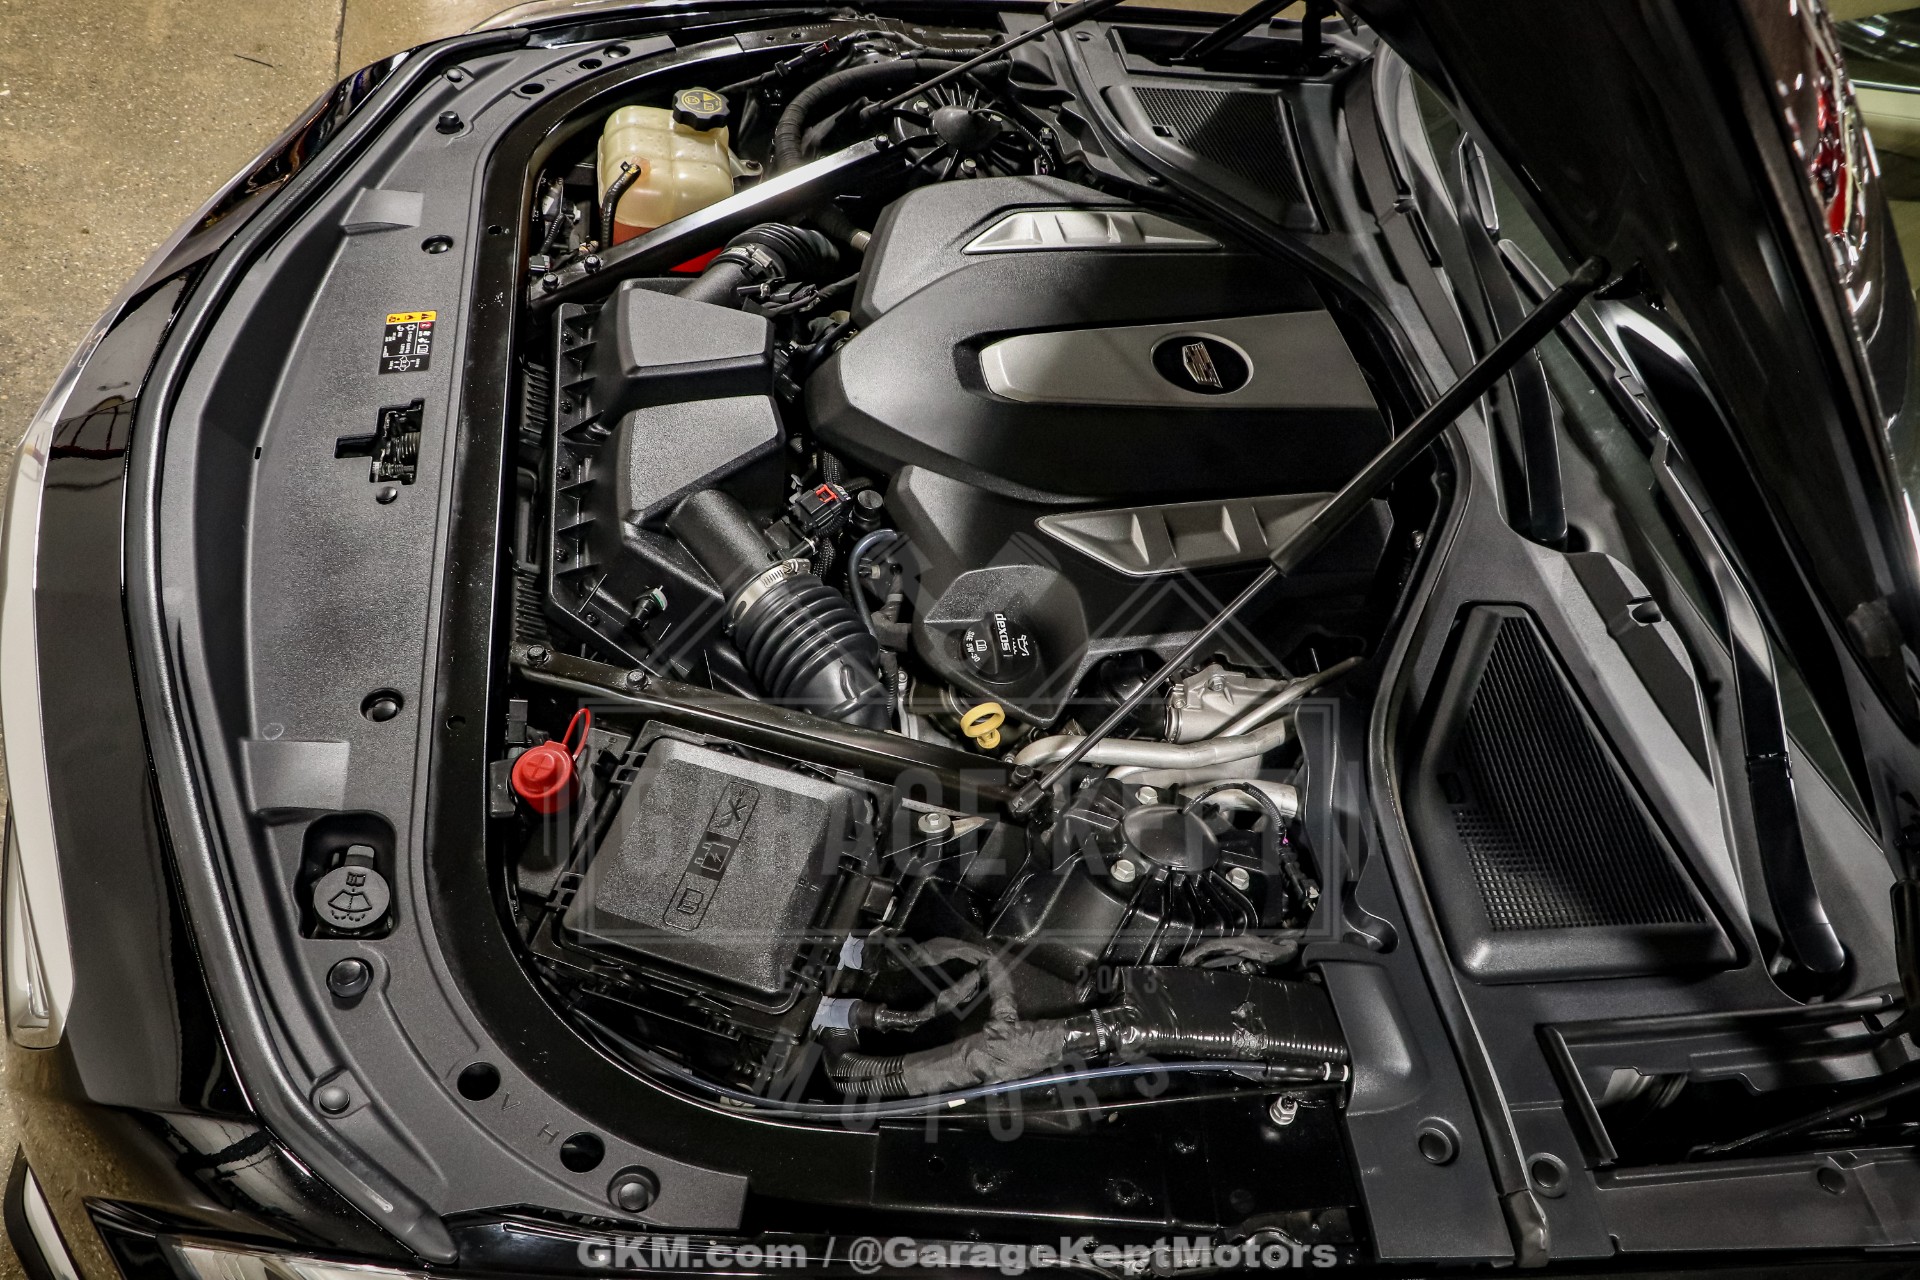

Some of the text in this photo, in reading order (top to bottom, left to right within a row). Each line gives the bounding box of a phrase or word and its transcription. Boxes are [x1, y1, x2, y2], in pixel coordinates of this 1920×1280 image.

[965, 630, 981, 663] SAE 5W-30
[994, 613, 1011, 652] dexos
